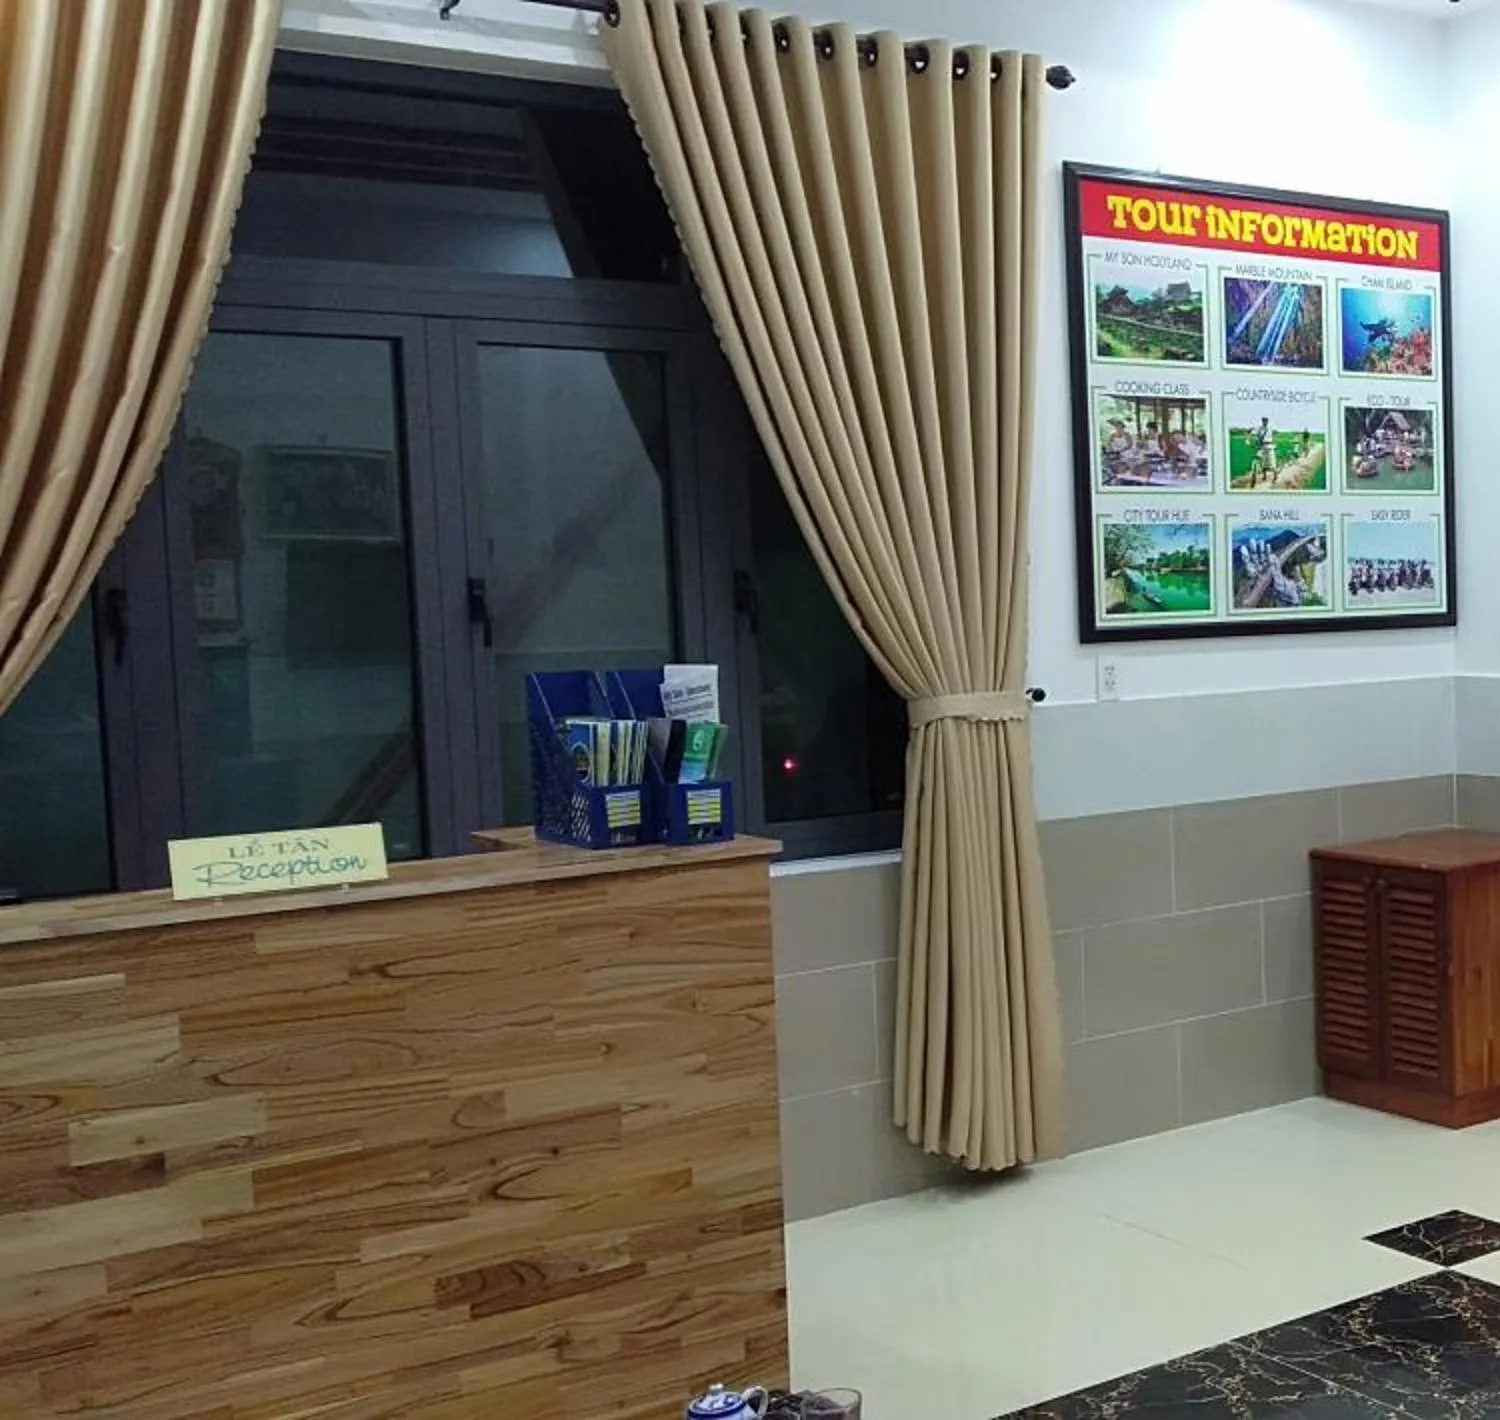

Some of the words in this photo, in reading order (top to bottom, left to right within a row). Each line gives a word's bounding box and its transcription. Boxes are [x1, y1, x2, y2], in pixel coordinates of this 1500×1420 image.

[1235, 263, 1267, 277] MARBLE
[1114, 380, 1162, 395] COOKING
[1162, 383, 1190, 396] CLASS
[1123, 509, 1144, 523] CITY
[1145, 509, 1170, 523] TOUR
[1172, 509, 1192, 523] HUE
[192, 853, 369, 889] Reception
